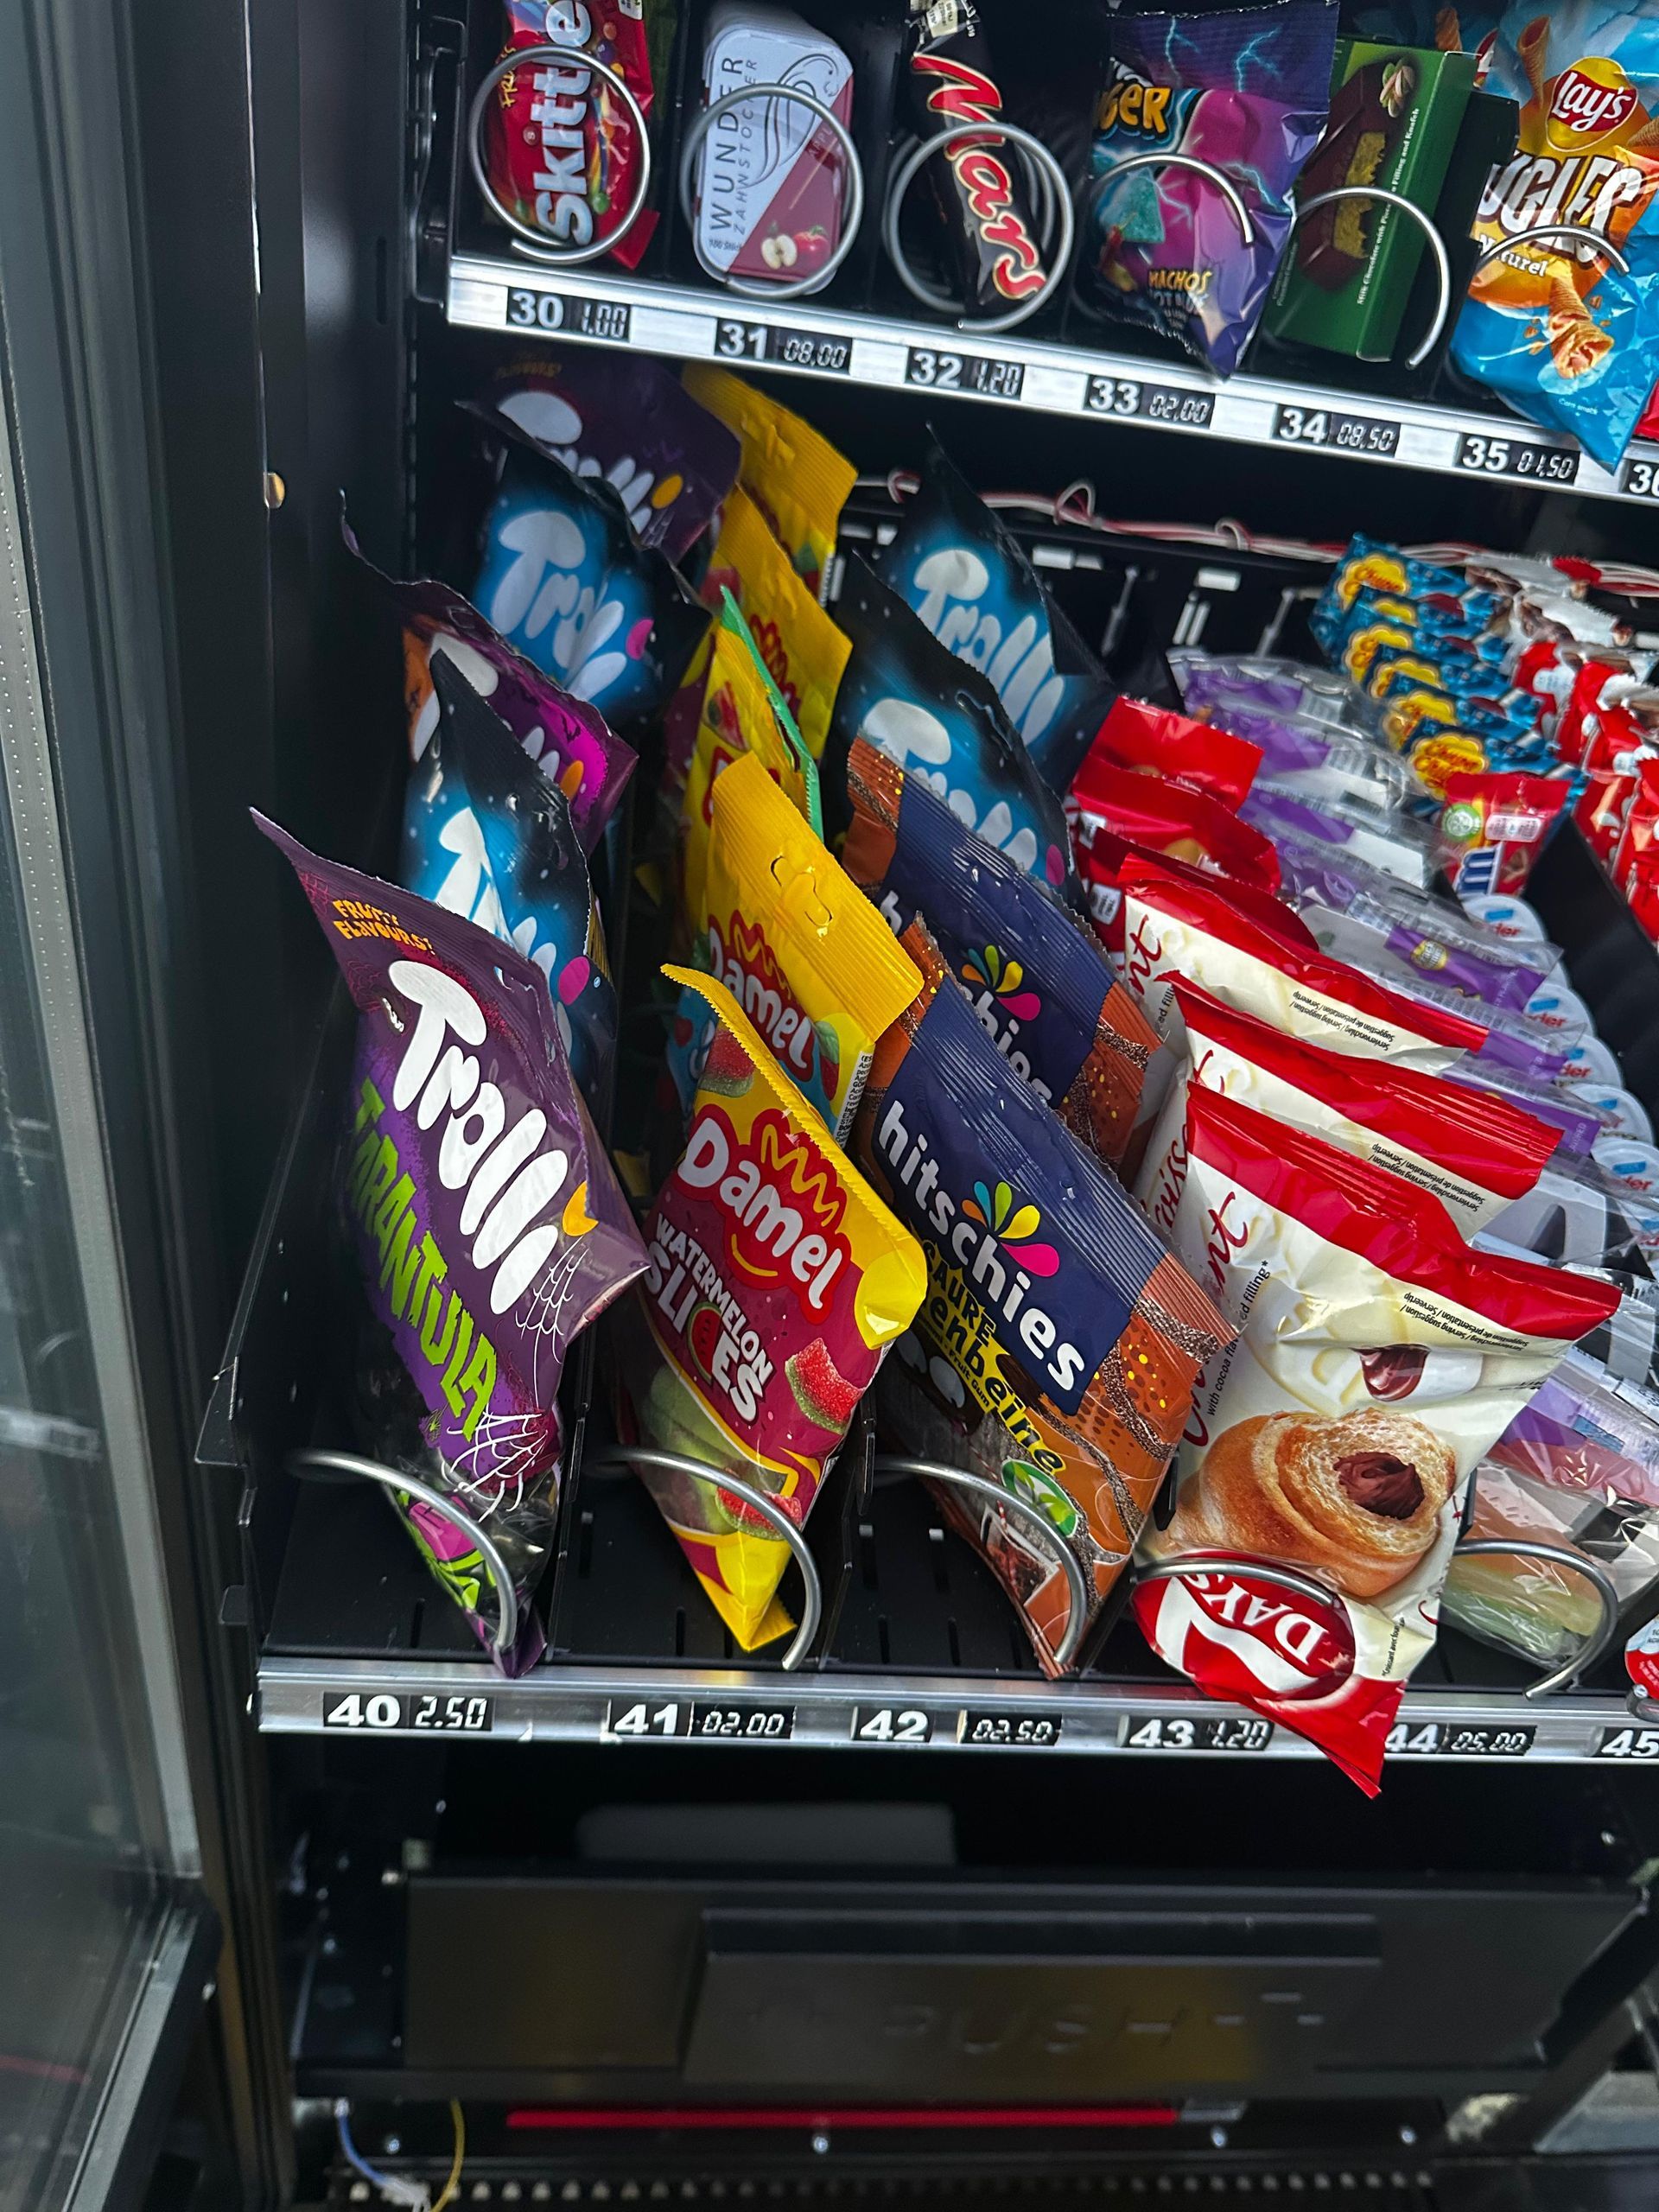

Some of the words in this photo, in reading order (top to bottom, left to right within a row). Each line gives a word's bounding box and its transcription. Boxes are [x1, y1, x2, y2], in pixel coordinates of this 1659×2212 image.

[1551, 72, 1632, 132] Lay's
[734, 60, 758, 236] ZAHNSTOCER
[912, 53, 1047, 300] Mars
[1477, 150, 1643, 263] UGLES
[509, 292, 564, 330] 30
[582, 303, 628, 339] 1.00
[719, 320, 767, 359] 31
[783, 338, 848, 369] 08.00
[911, 351, 963, 389] 32
[976, 359, 1020, 396] 1.20
[1089, 378, 1141, 415] 33
[1148, 393, 1211, 423] 02.00
[1279, 407, 1328, 444] 34
[1336, 422, 1396, 452] 08.50
[1462, 436, 1511, 473] 35
[1516, 451, 1575, 480] 01.50
[1294, 1002, 1321, 1020] suggestion
[1321, 1015, 1341, 1030] Serving
[1363, 1022, 1395, 1042] Suggestion
[388, 959, 599, 1315] Trolli
[1371, 1143, 1403, 1165] Serveertip
[1373, 1156, 1405, 1176] suggestion
[1404, 1172, 1428, 1189] Serving
[678, 1117, 843, 1310] Damel
[1452, 1185, 1485, 1205] Suggestion
[348, 1077, 497, 1442] TARANTULA
[878, 1100, 1084, 1391] hitschies
[654, 1212, 774, 1389] WATERMELON
[921, 1241, 997, 1347] SAURE
[1403, 1292, 1439, 1316] Serveertip
[1405, 1306, 1441, 1328] suggestion
[1440, 1323, 1466, 1340] Serving
[930, 1296, 1064, 1470] enbeine
[970, 1378, 990, 1408] Gum
[1207, 1392, 1220, 1416] with
[1214, 1359, 1232, 1392] cocoa
[327, 1694, 401, 1728] 40
[415, 1695, 489, 1729] 2.50
[614, 1704, 680, 1736] 41
[701, 1711, 785, 1736] 02.00
[859, 1709, 928, 1742] 42
[971, 1718, 1053, 1743] 02.50
[1128, 1719, 1195, 1749] 43
[1384, 1723, 1439, 1753] 44
[1452, 1731, 1528, 1754] 05.00
[1600, 1730, 1659, 1757] 45
